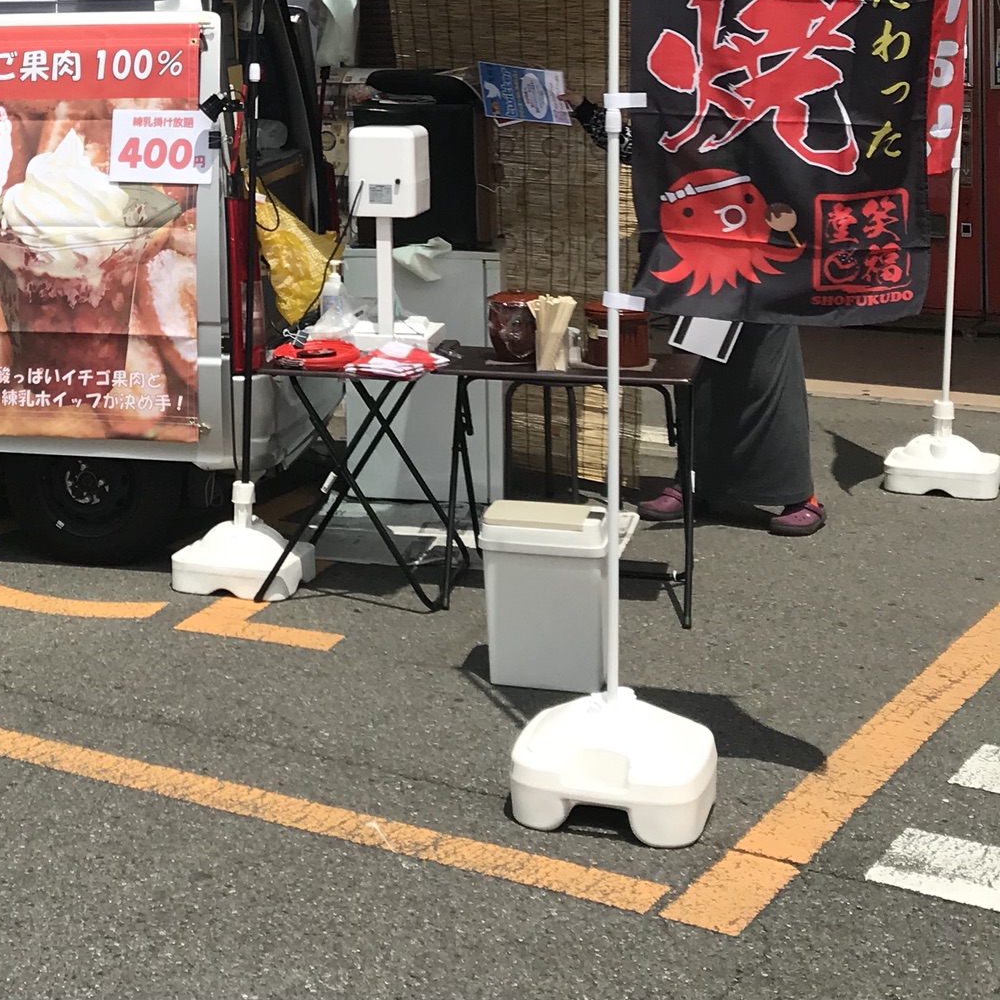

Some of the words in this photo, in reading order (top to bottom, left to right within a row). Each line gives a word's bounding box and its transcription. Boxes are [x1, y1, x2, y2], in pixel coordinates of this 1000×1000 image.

[95, 48, 184, 81] 100%
[117, 136, 206, 170] 400円
[810, 288, 915, 308] SHOFUKUDO
